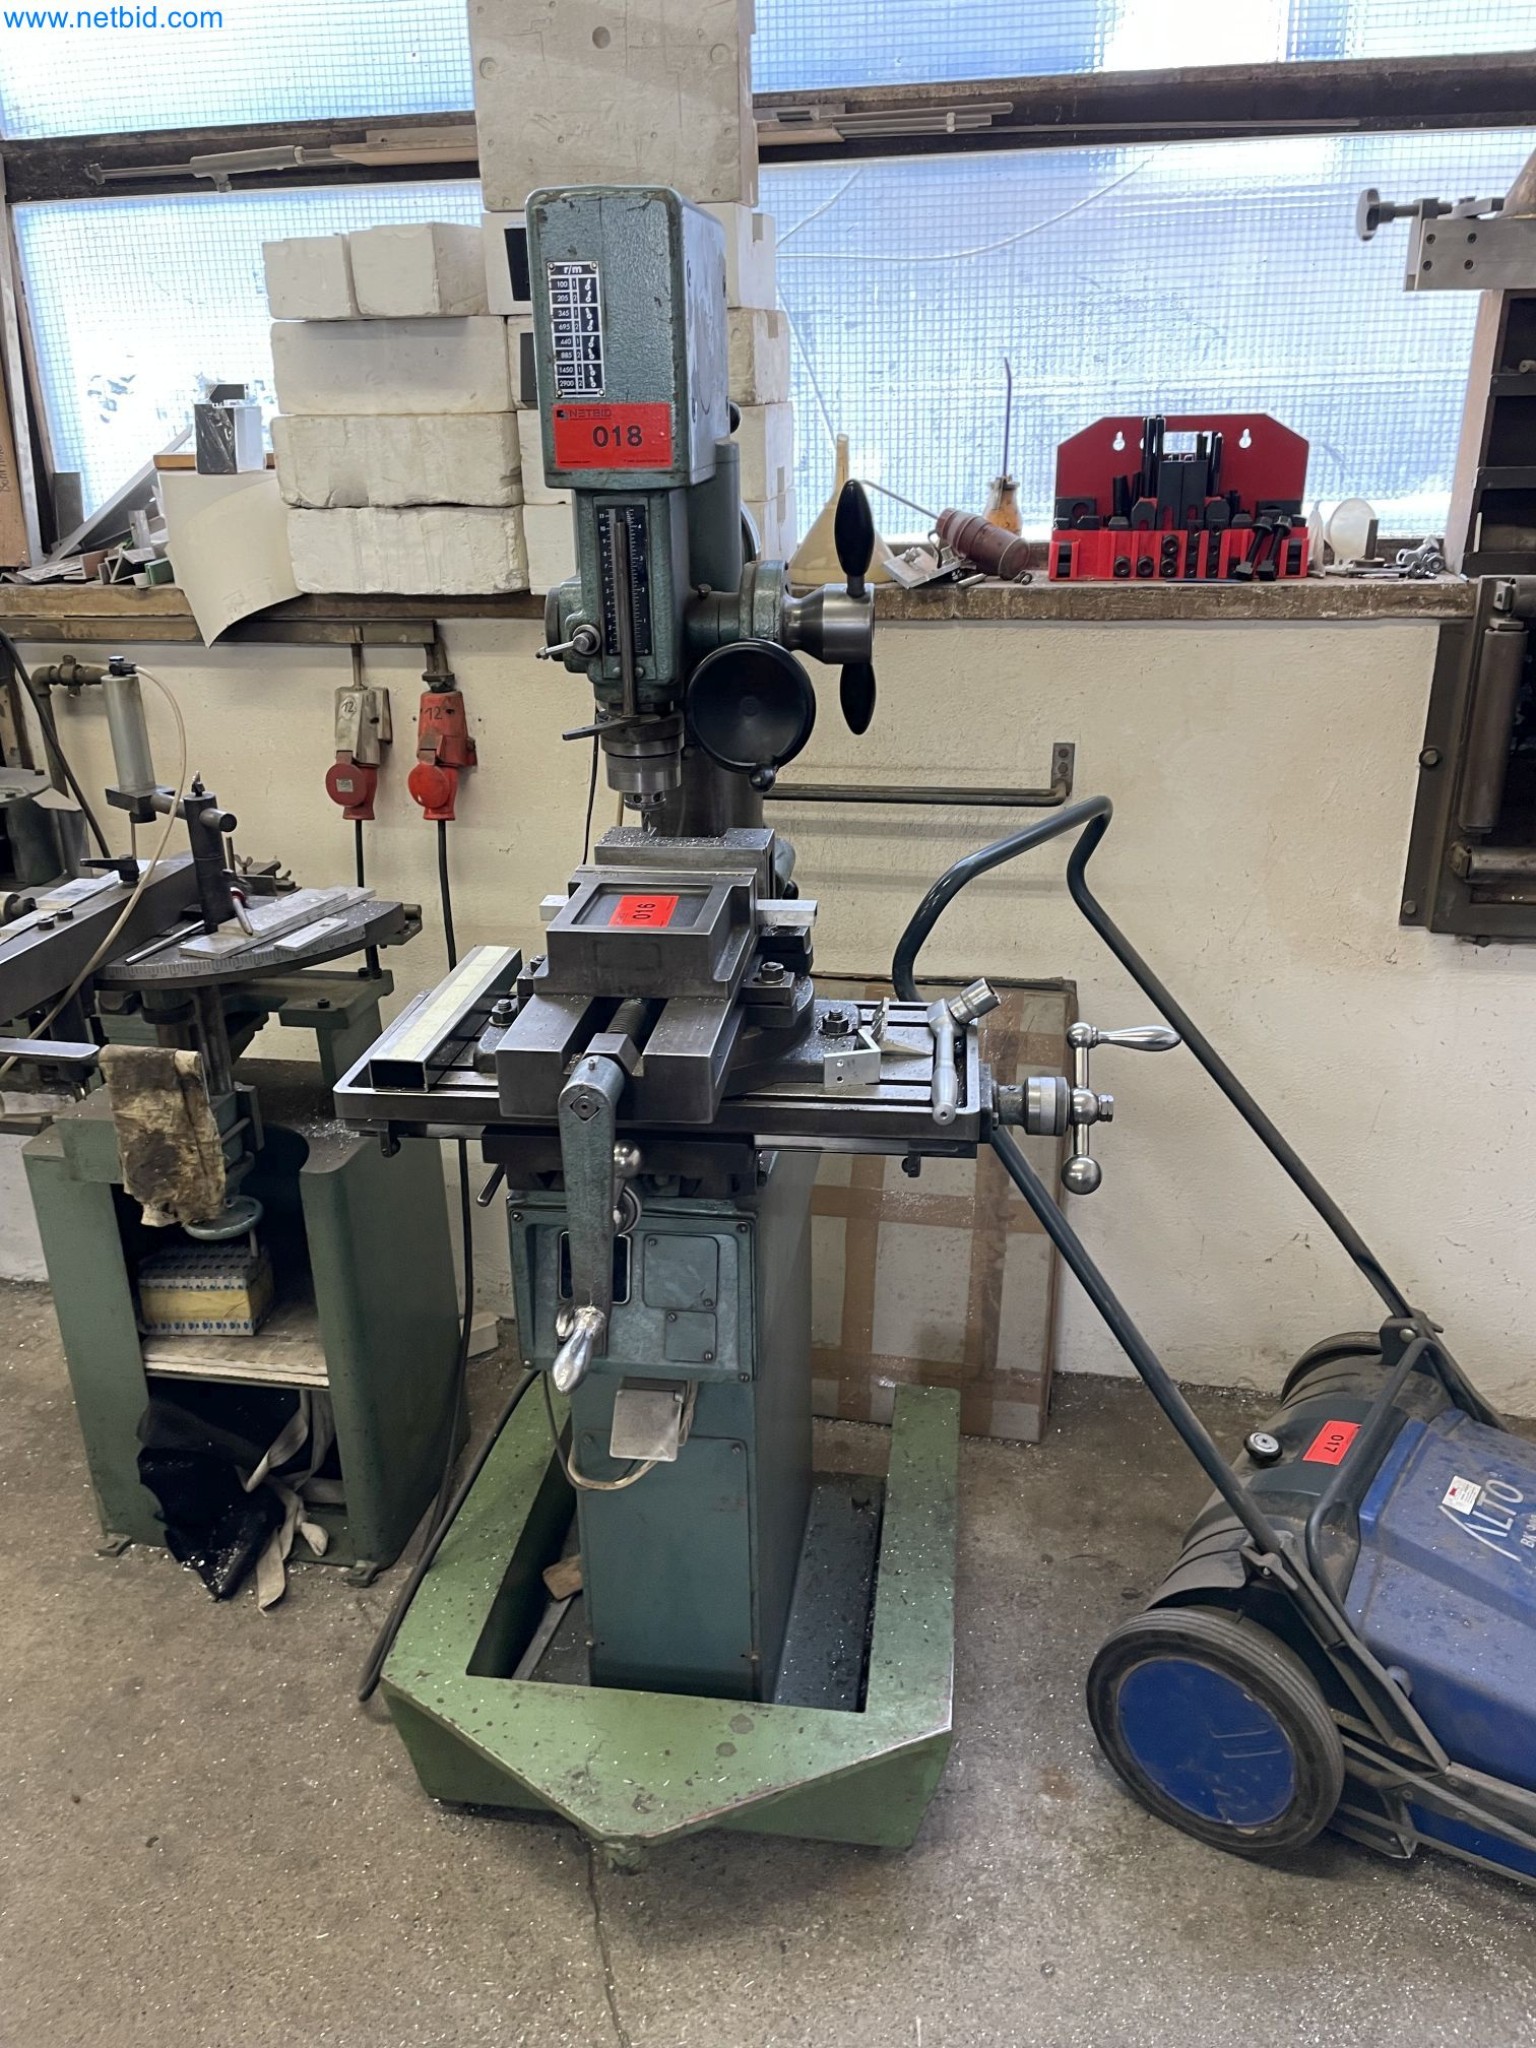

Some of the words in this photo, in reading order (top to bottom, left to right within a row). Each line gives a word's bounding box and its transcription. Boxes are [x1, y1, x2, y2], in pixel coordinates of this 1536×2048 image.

[563, 265, 583, 275] r/m
[556, 280, 568, 288] 100
[557, 294, 569, 302] 205
[558, 309, 570, 317] 345
[558, 323, 571, 331] 695
[560, 351, 573, 359] 885
[569, 409, 612, 417] NETBID
[592, 425, 643, 447] 018
[341, 700, 356, 713] 12
[424, 706, 443, 720] 12
[632, 903, 656, 919] 016
[1323, 1435, 1345, 1453] 017
[1438, 1479, 1524, 1561] ALTO
